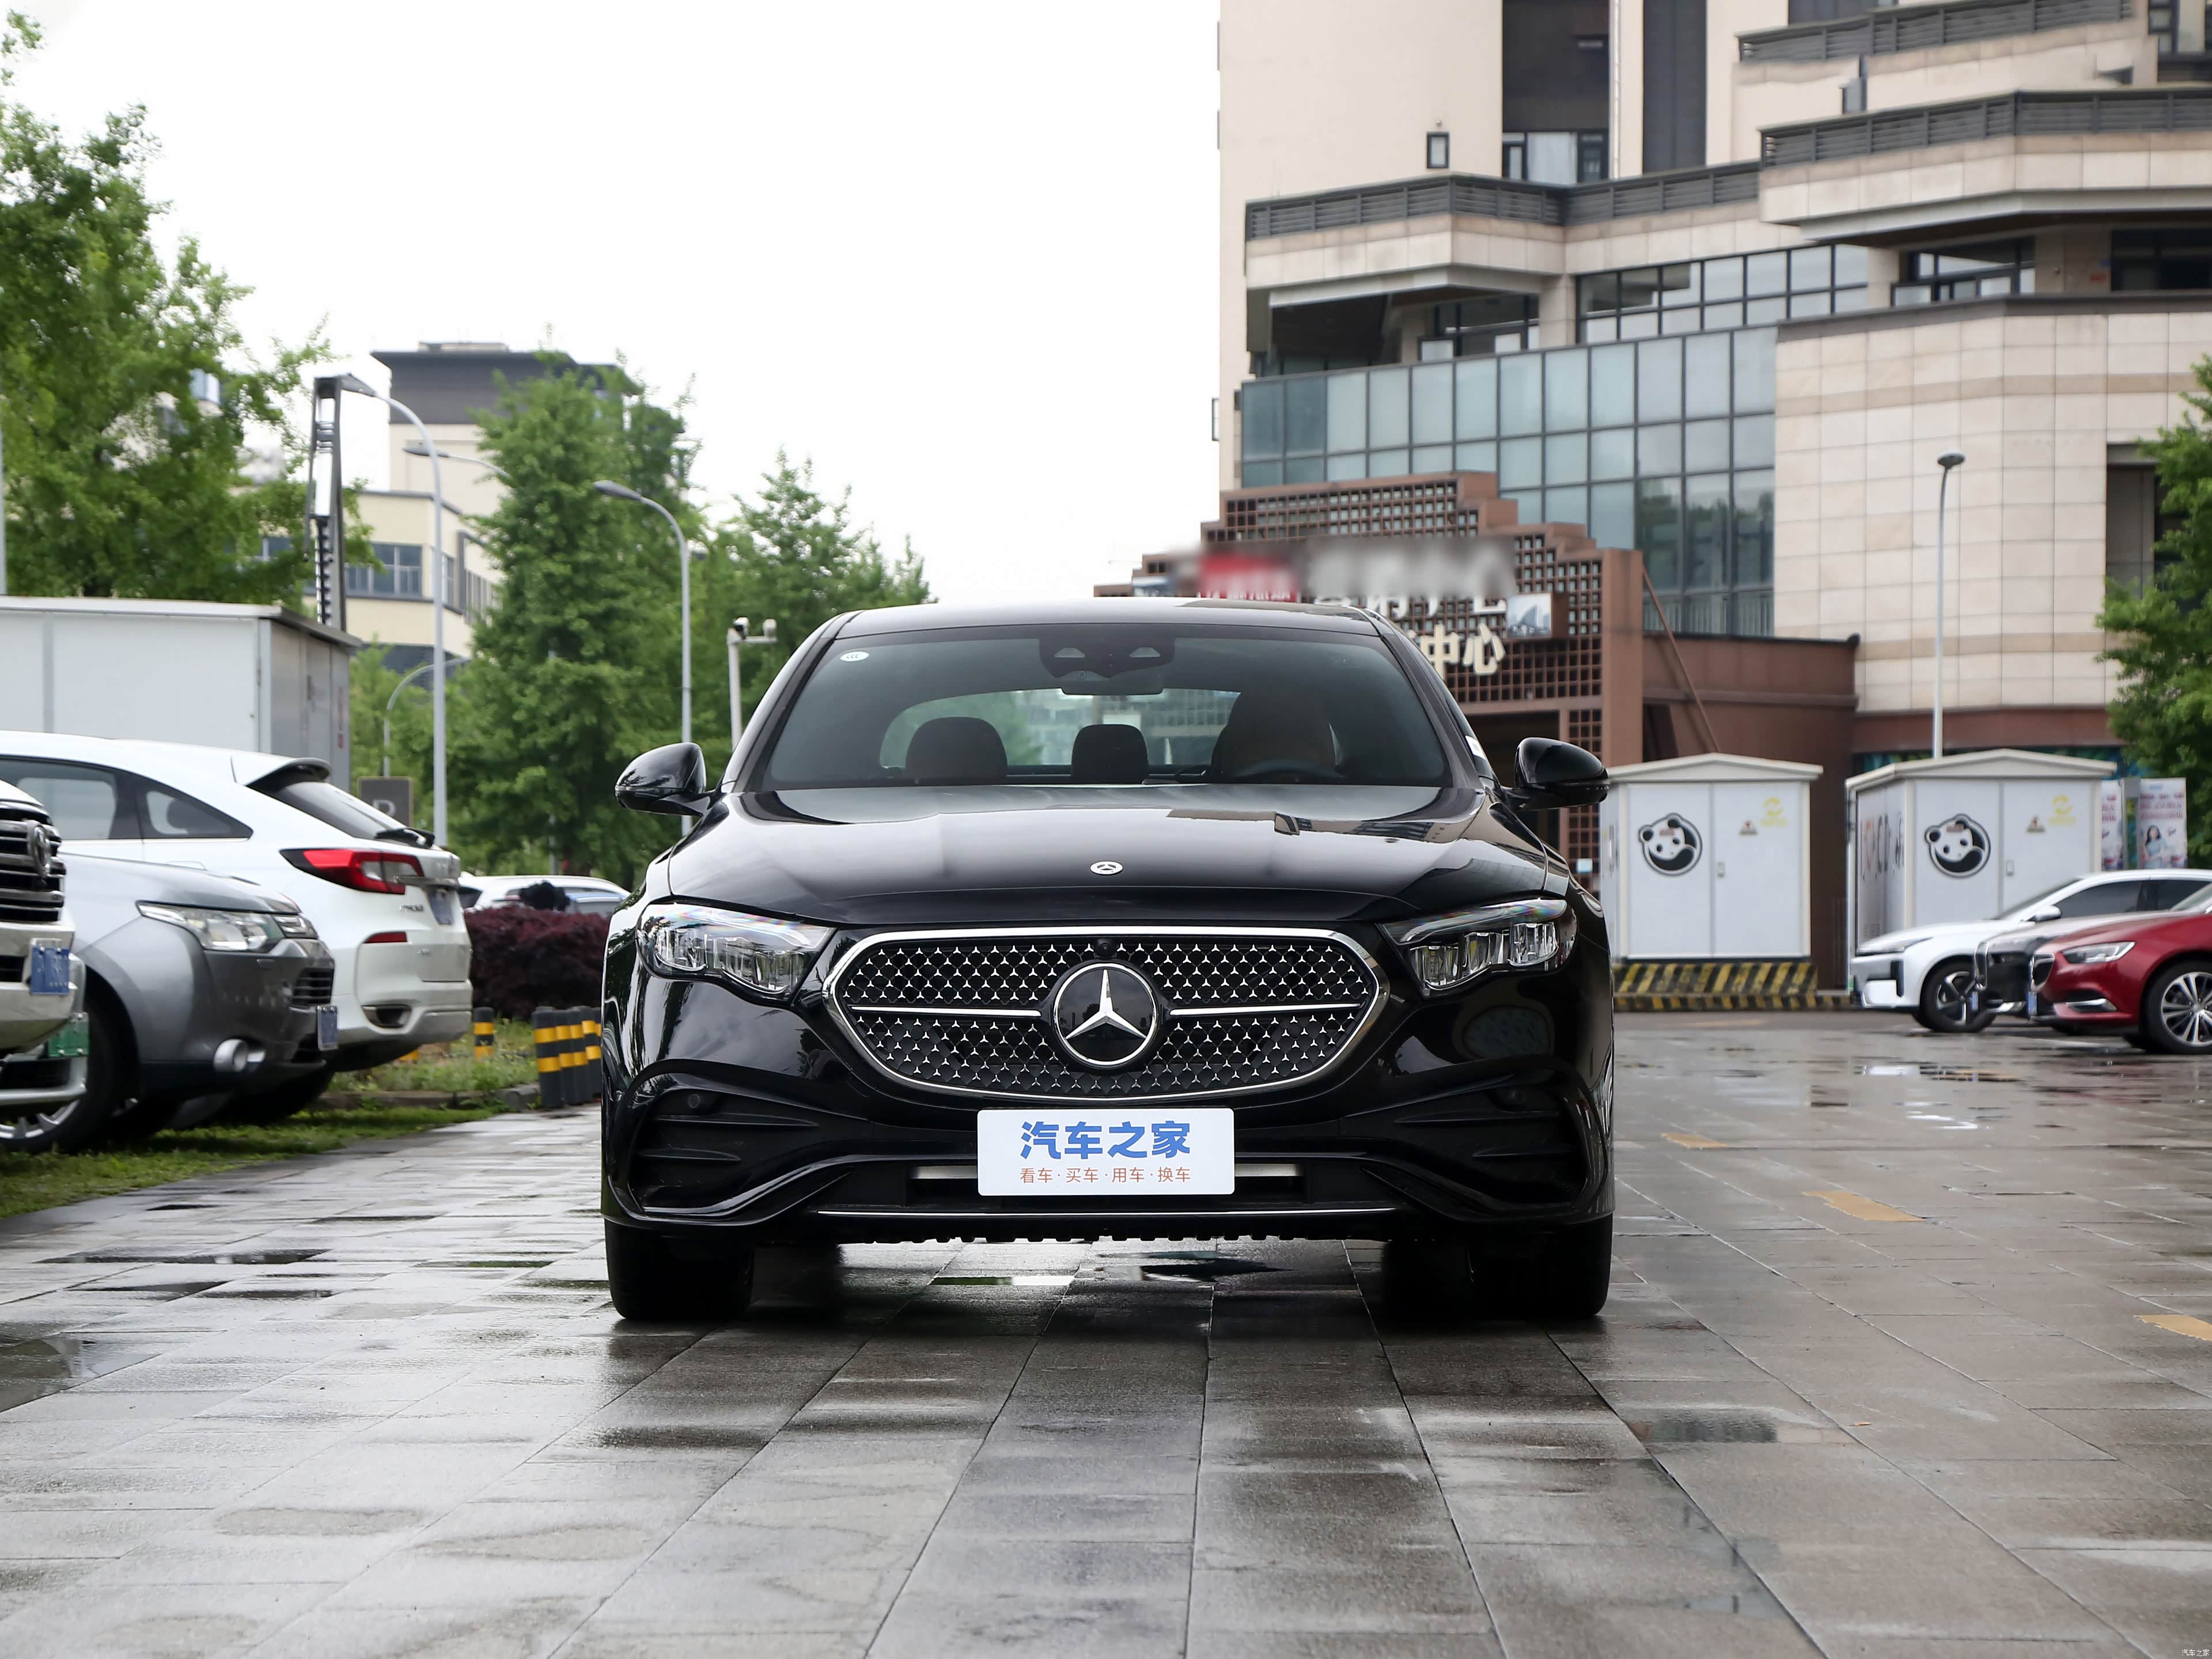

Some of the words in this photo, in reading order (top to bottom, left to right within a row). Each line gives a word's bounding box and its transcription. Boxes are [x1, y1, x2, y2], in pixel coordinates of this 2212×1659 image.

[1406, 623, 1506, 681] 中心
[1020, 1120, 1191, 1160] 汽车之家
